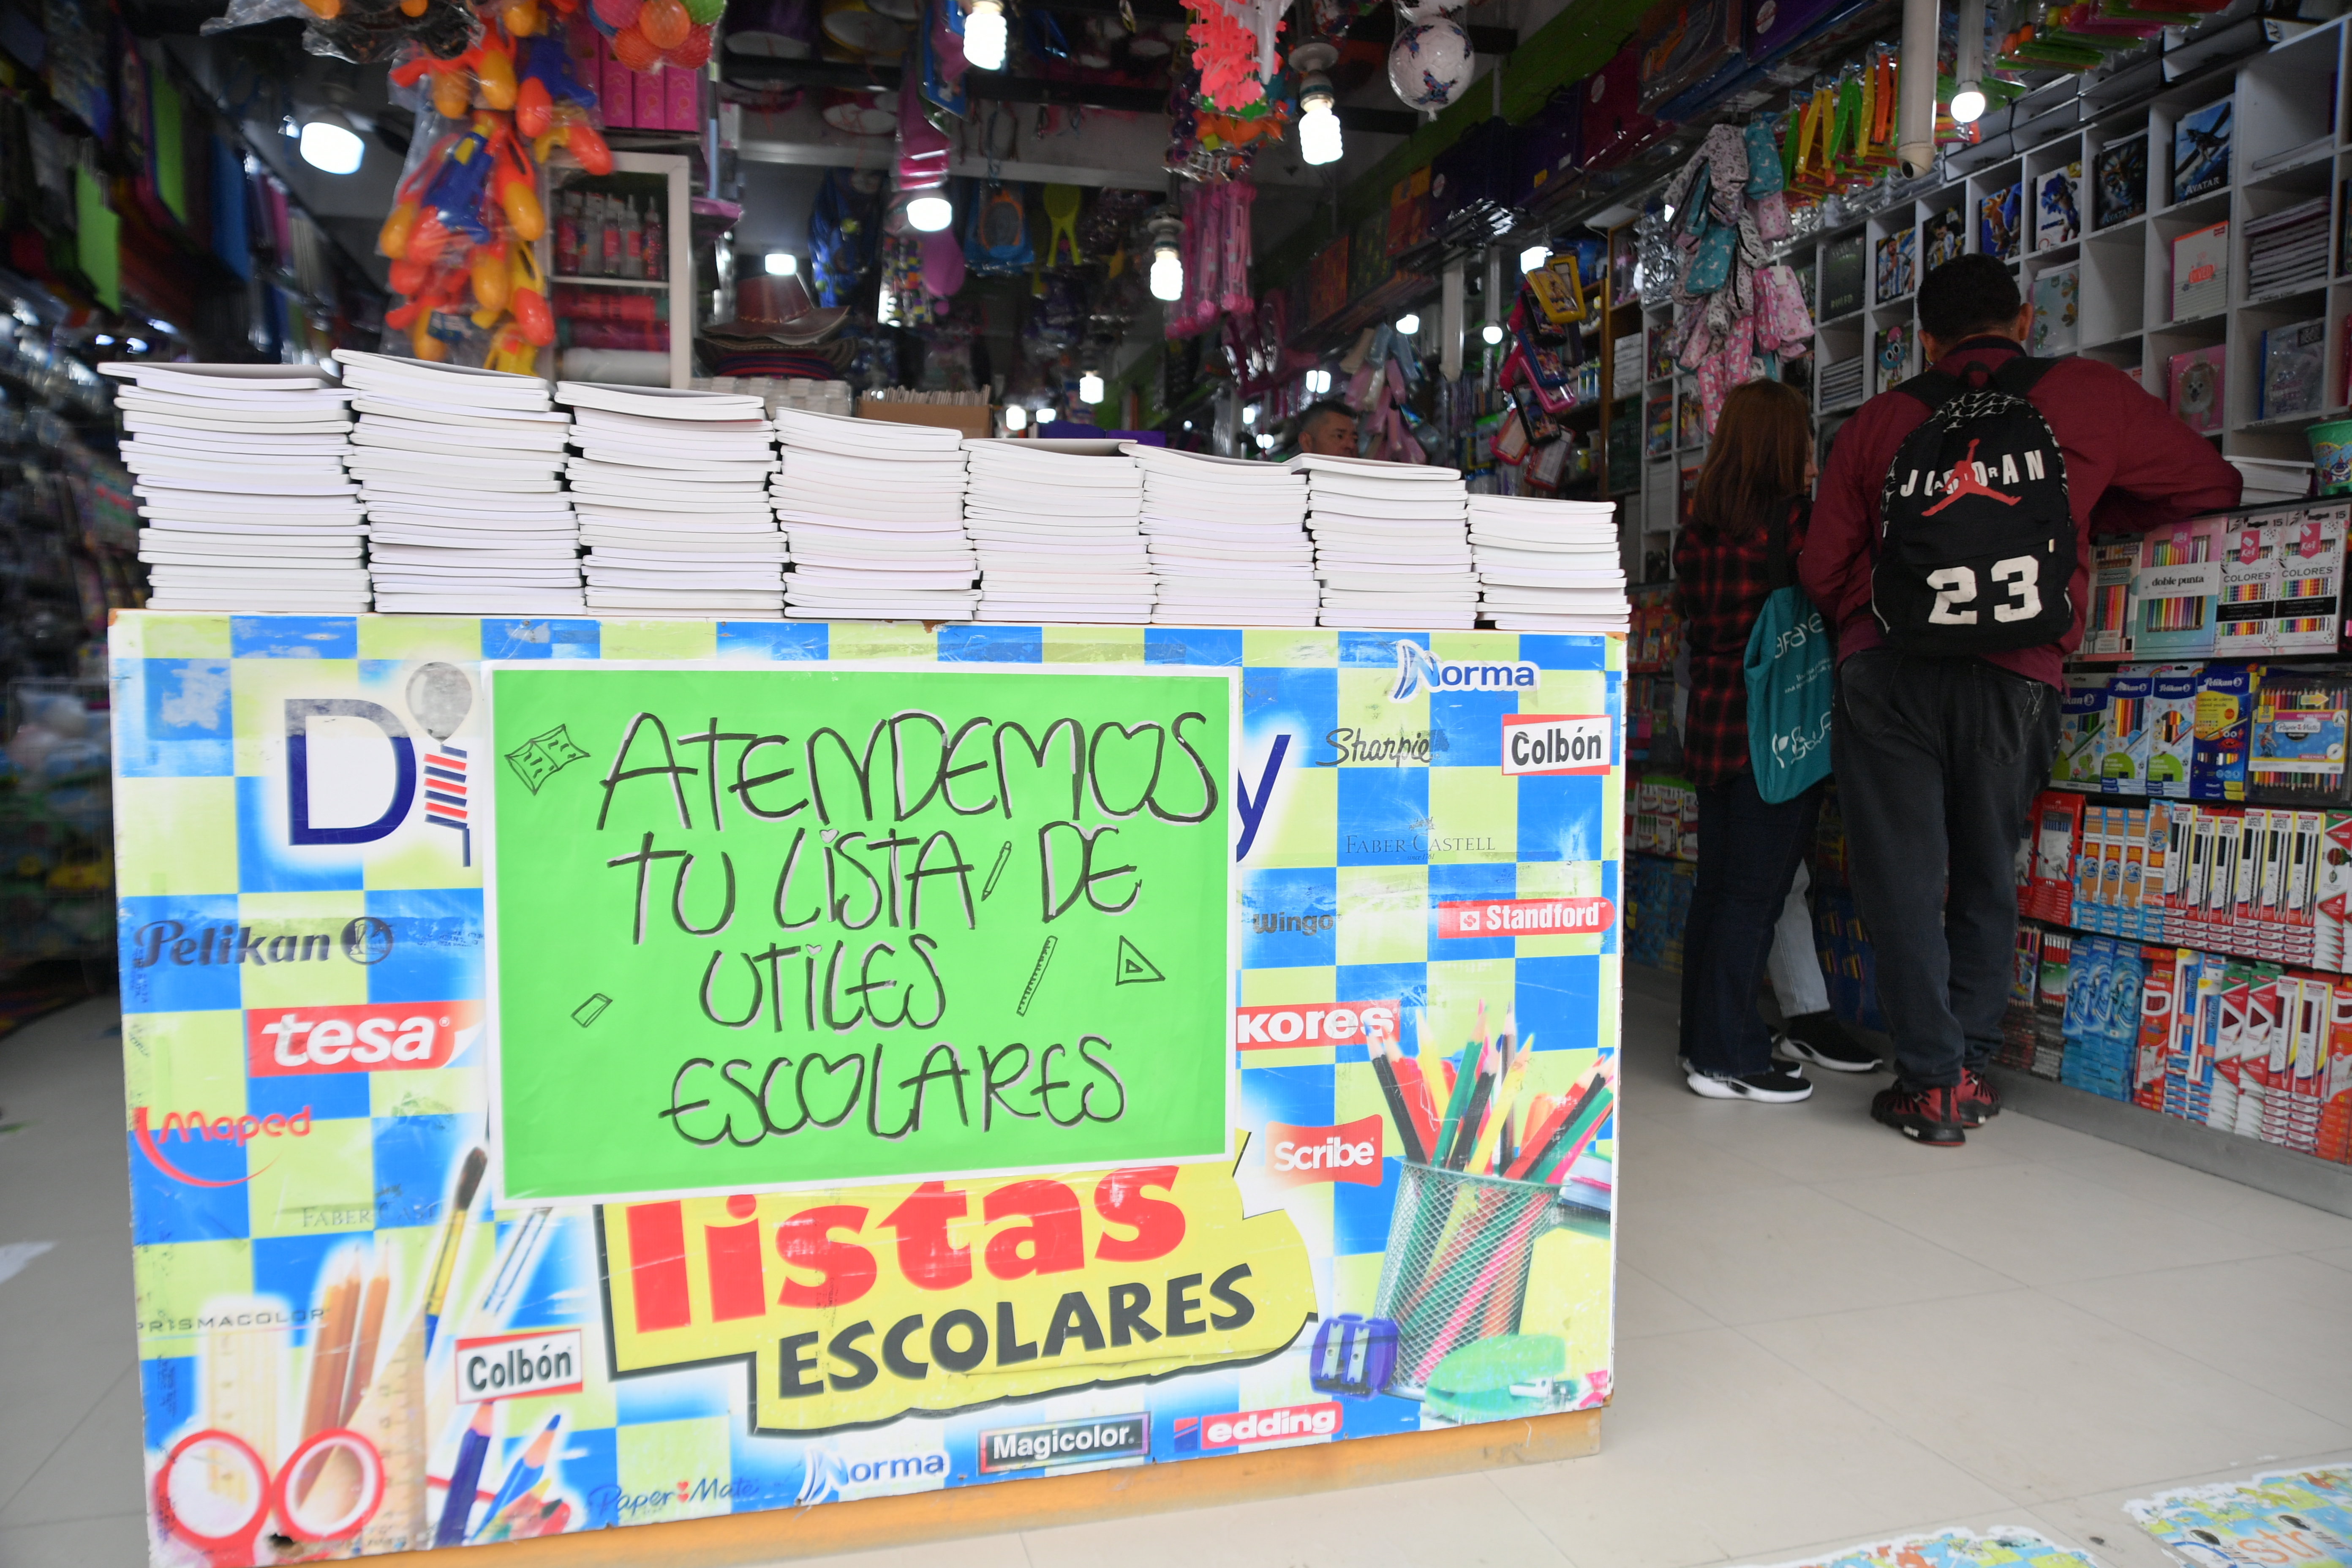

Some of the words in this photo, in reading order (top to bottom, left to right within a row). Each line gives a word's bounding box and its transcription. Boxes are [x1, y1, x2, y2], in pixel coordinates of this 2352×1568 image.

[2186, 177, 2220, 196] AVATAR
[2102, 207, 2132, 225] AVATAR
[2336, 511, 2346, 519] 15
[2152, 577, 2176, 586] doble
[2178, 575, 2204, 586] punta
[2223, 572, 2271, 583] COLORES
[2282, 566, 2333, 577] COLORES
[1926, 555, 2043, 625] 23
[1393, 641, 1535, 700] Norma
[2159, 682, 2182, 692] Pelikan
[2204, 678, 2233, 687] Pelikan
[1315, 727, 1433, 768] Sharpie
[1511, 727, 1602, 766] Colbón
[596, 709, 1219, 831] ATENDEMOS
[1346, 833, 1495, 853] FABER-CASTELL
[606, 831, 736, 946] TU
[1038, 821, 1143, 923] DE
[1252, 913, 1334, 936] Wingo
[1486, 902, 1599, 929] Standford
[133, 920, 330, 966] Pelikan
[260, 1014, 434, 1067] tesa
[1236, 1007, 1394, 1043] kores
[658, 1035, 1128, 1148] ESCOLARES
[1274, 1138, 1375, 1172] Scribe
[302, 1201, 438, 1228] FABER-CAST
[625, 1165, 1187, 1334] listas
[779, 1263, 1256, 1399] ESCOLARES
[466, 1343, 572, 1393] Colbón
[993, 1425, 1131, 1460] Magicolor
[1207, 1407, 1337, 1443] edding
[797, 1446, 944, 1504] Norma
[589, 1484, 676, 1516] Paper
[691, 1478, 760, 1503] Mate
